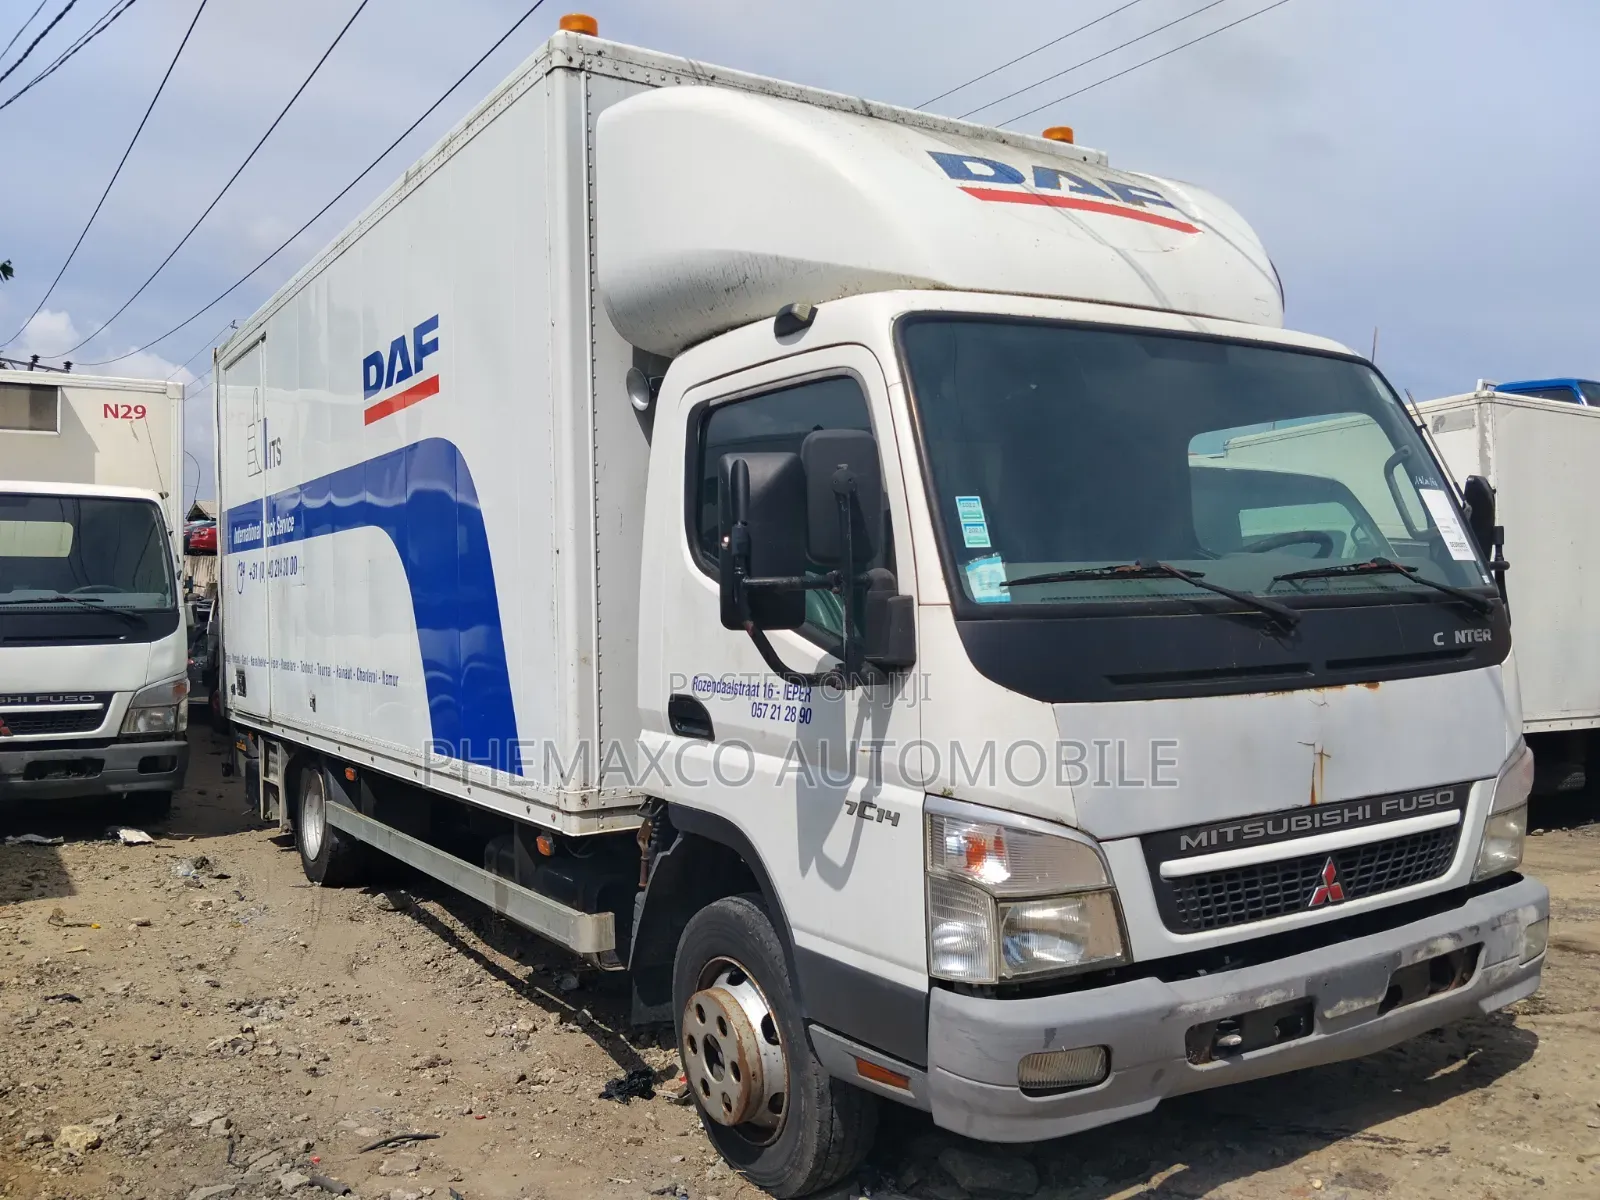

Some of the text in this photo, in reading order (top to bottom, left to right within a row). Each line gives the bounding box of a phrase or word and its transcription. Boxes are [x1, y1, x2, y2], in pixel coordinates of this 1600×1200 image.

[924, 150, 1177, 209] DAF
[362, 313, 439, 401] DAF
[103, 403, 147, 420] N29
[269, 436, 282, 470] ITS
[233, 512, 295, 545] International uck Service
[249, 561, 258, 580] +31
[1433, 628, 1492, 646] CNTER
[381, 670, 399, 687] Namur
[692, 675, 760, 698] Rozendaalstraat
[762, 682, 774, 699] 16
[783, 683, 812, 703] IEPER
[36, 695, 95, 703] FUSO
[751, 701, 812, 725] 057 21 28 90
[844, 800, 901, 827] 7C14
[1180, 790, 1455, 851] MITSUBISHI FUSO
